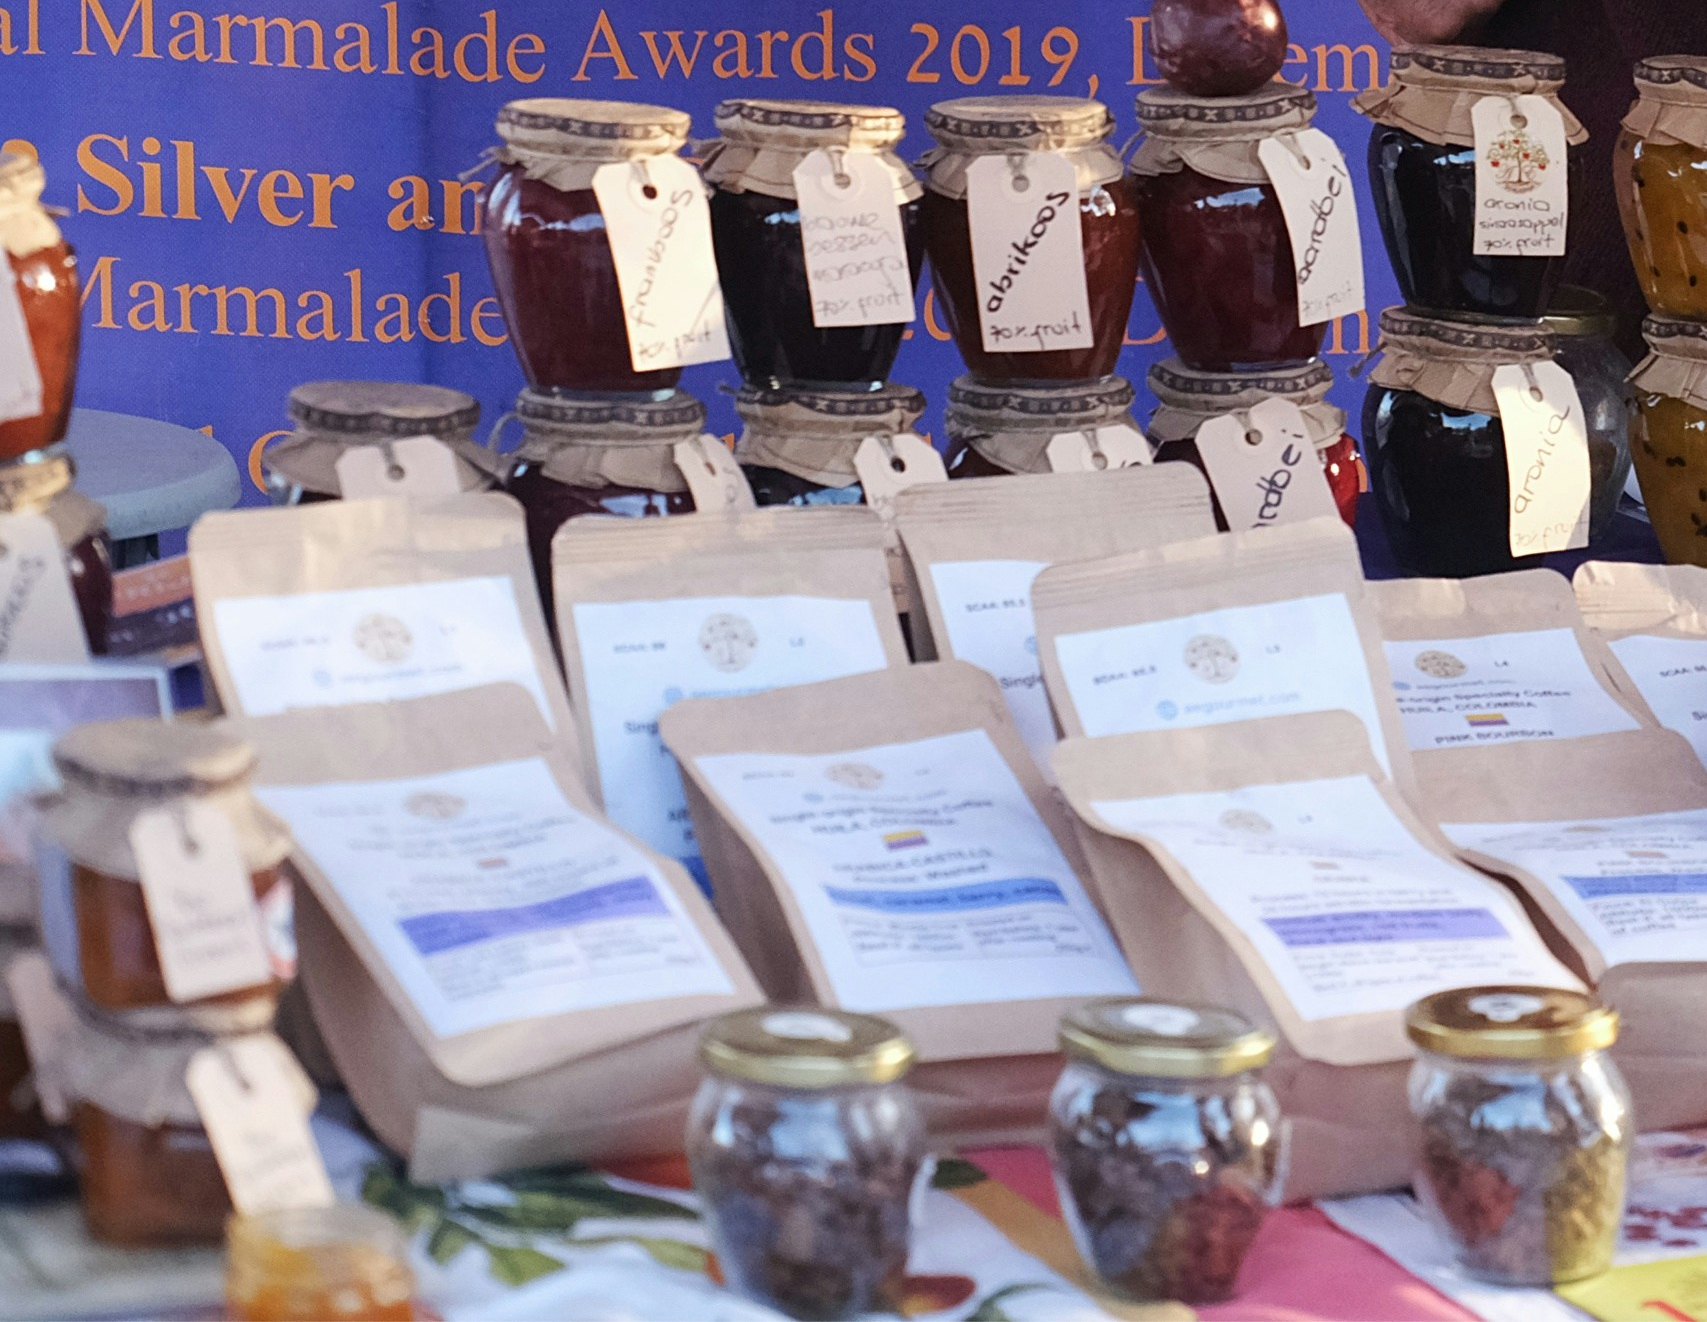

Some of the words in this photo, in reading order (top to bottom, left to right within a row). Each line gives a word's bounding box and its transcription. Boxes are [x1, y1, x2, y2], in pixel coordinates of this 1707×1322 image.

[571, 9, 876, 83] Awards
[905, 22, 1100, 98] 2019,
[77, 133, 355, 230] Silver
[1484, 197, 1550, 212] aronia
[986, 188, 1070, 313] abrikoos
[1516, 234, 1555, 255] fruit
[1029, 314, 1082, 351] fruit
[1513, 405, 1571, 514] aronia
